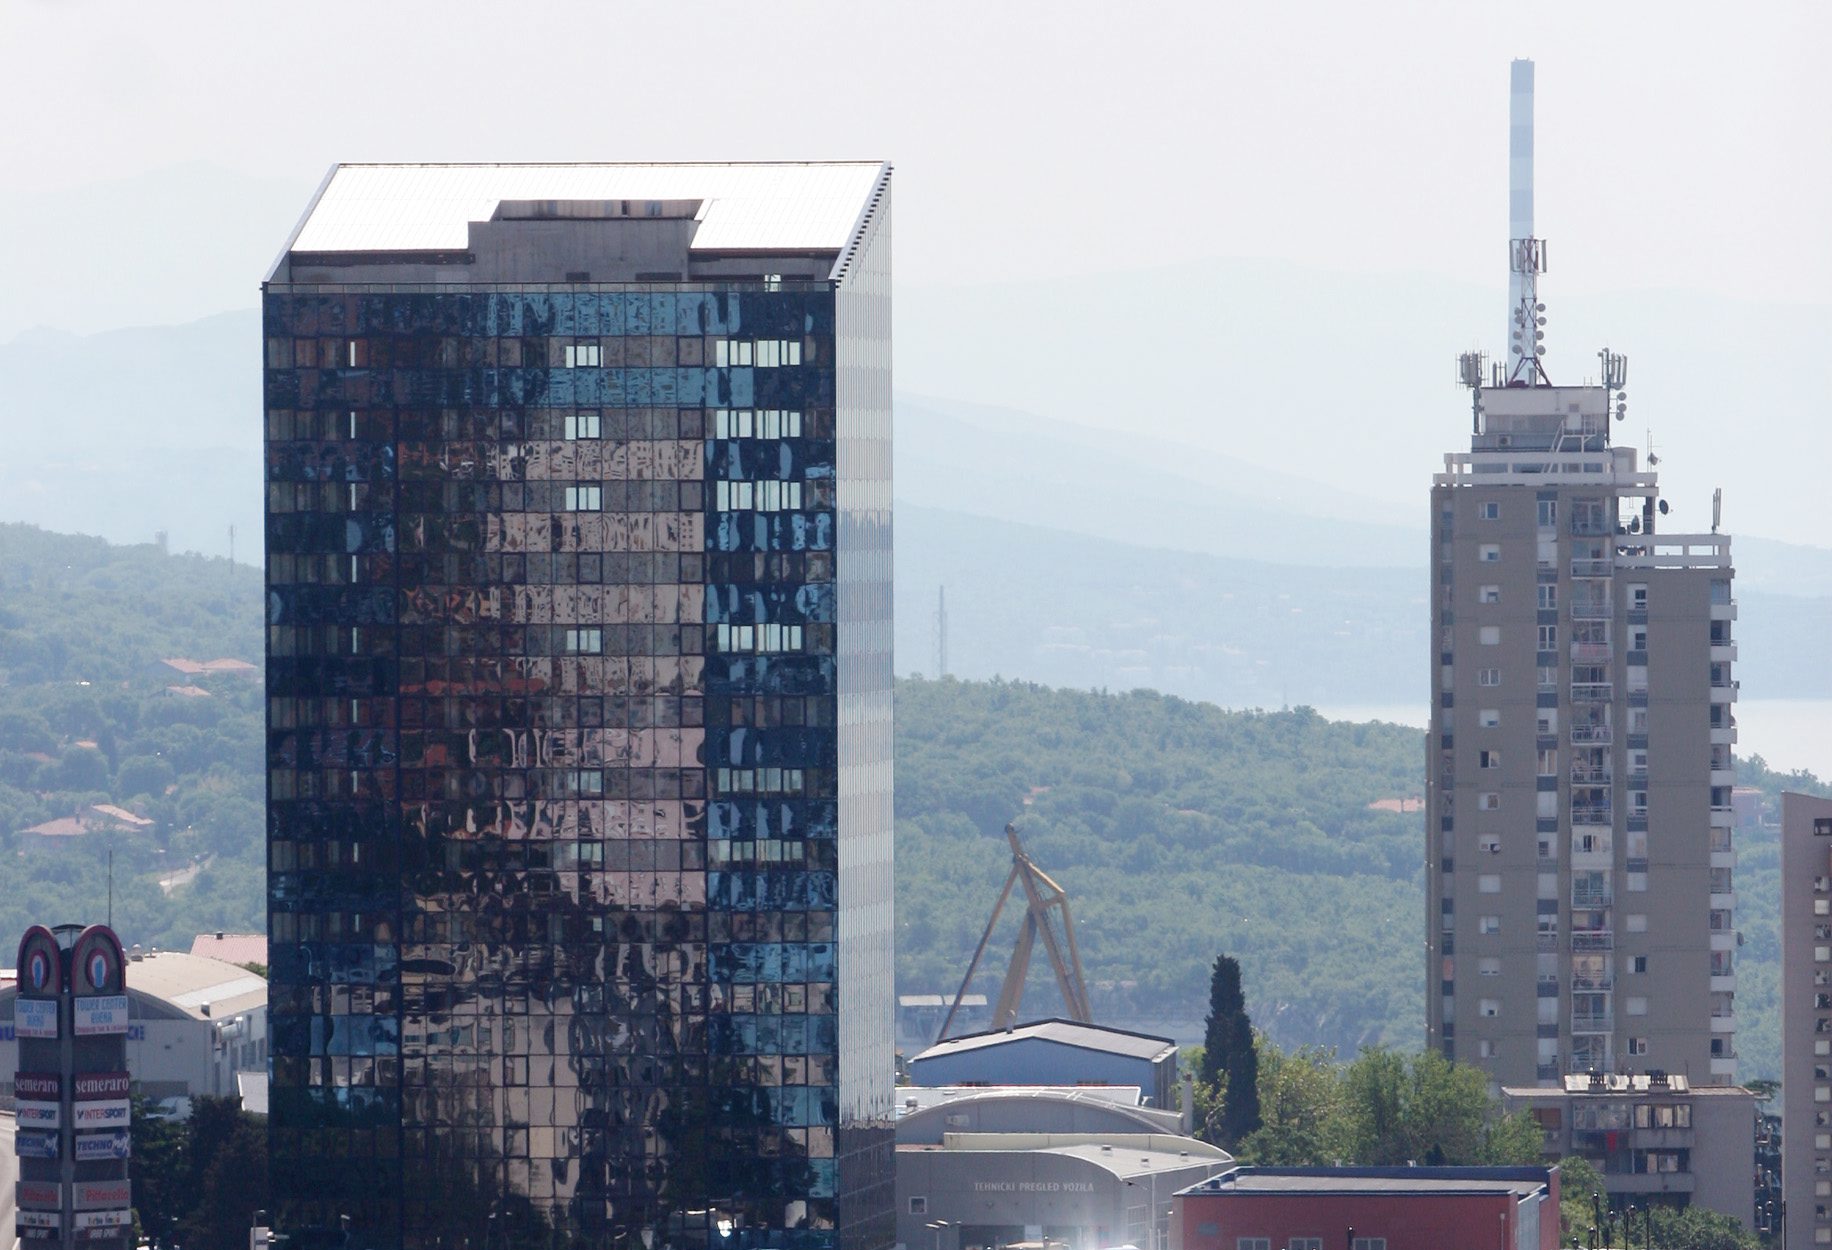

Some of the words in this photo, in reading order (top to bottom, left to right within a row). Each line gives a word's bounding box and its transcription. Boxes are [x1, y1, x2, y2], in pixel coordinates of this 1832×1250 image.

[16, 1078, 58, 1093] semeraro
[75, 1077, 129, 1094] semeraro
[23, 1108, 57, 1121] INTERSPORT
[84, 1107, 127, 1121] INTERSPORT
[77, 1139, 113, 1151] TECHNO
[1019, 1182, 1060, 1192] PREGLED
[1062, 1182, 1095, 1192] VOZILA
